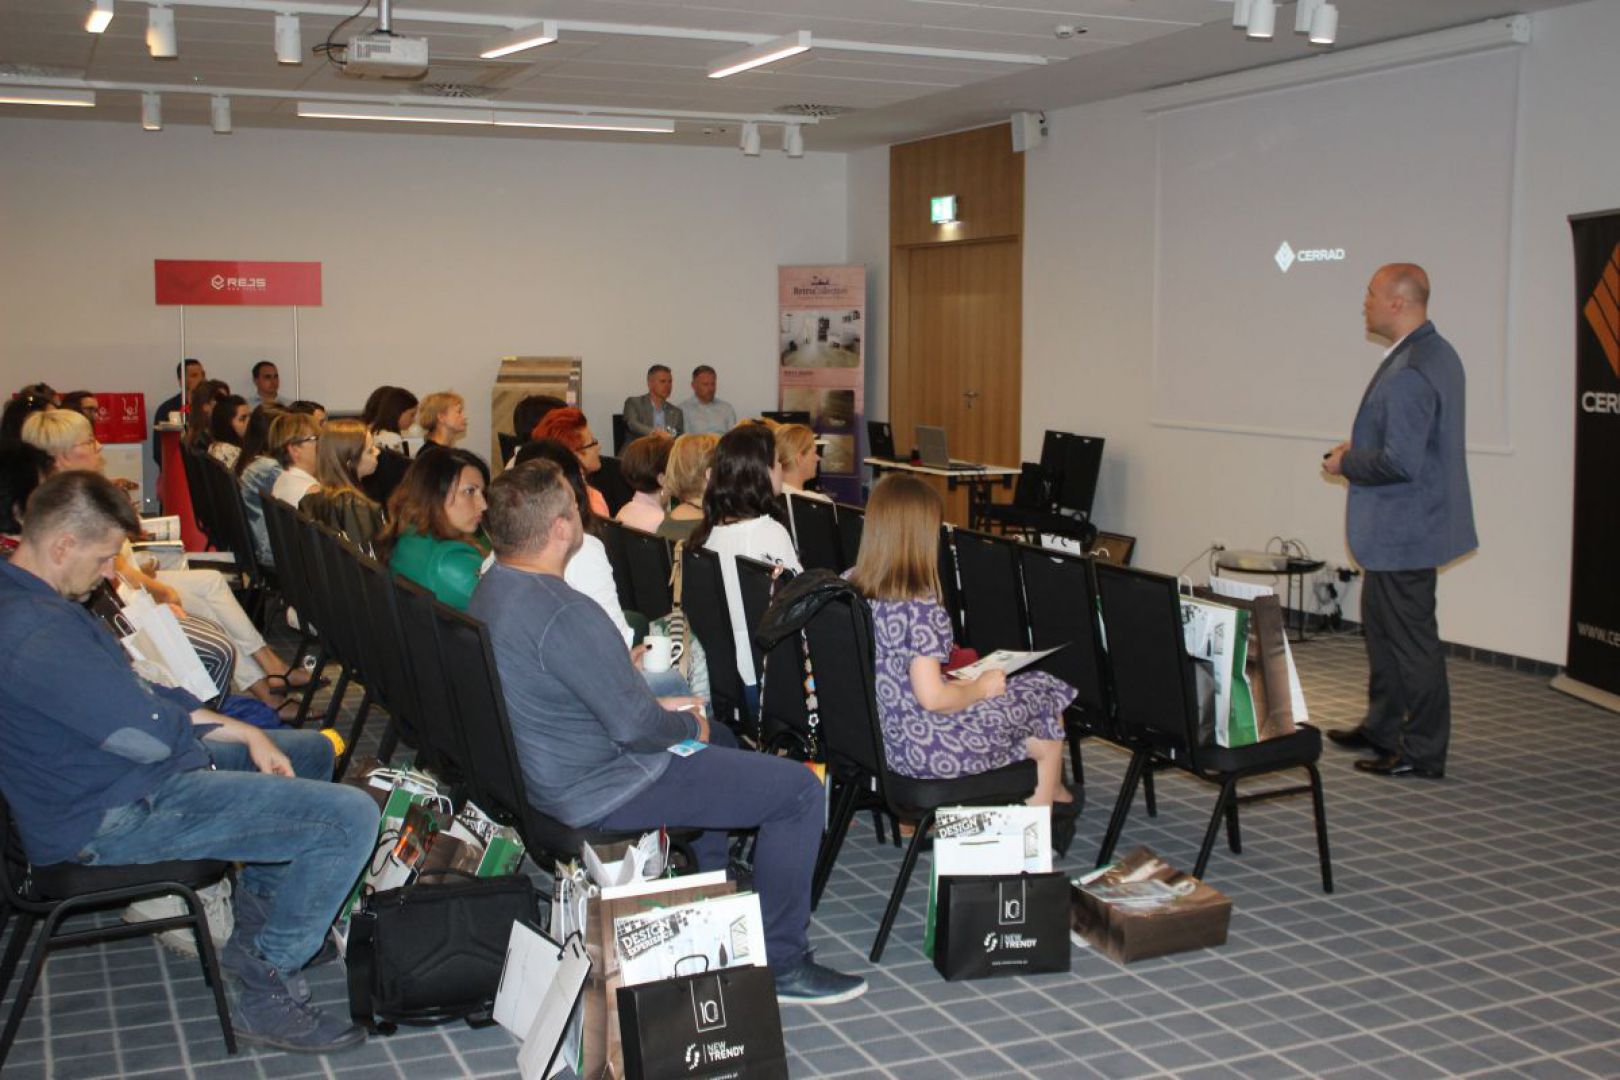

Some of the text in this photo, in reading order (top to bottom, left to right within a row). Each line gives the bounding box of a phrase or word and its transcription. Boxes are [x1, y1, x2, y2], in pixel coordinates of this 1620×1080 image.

[1297, 248, 1346, 261] CERRAD
[227, 277, 267, 287] REJS
[1581, 391, 1620, 413] CER
[939, 818, 979, 838] DESIGN
[622, 920, 672, 948] DESIGN
[1005, 938, 1038, 949] TRENDY
[706, 1041, 726, 1053] NEW
[708, 1044, 745, 1062] TRENDY
